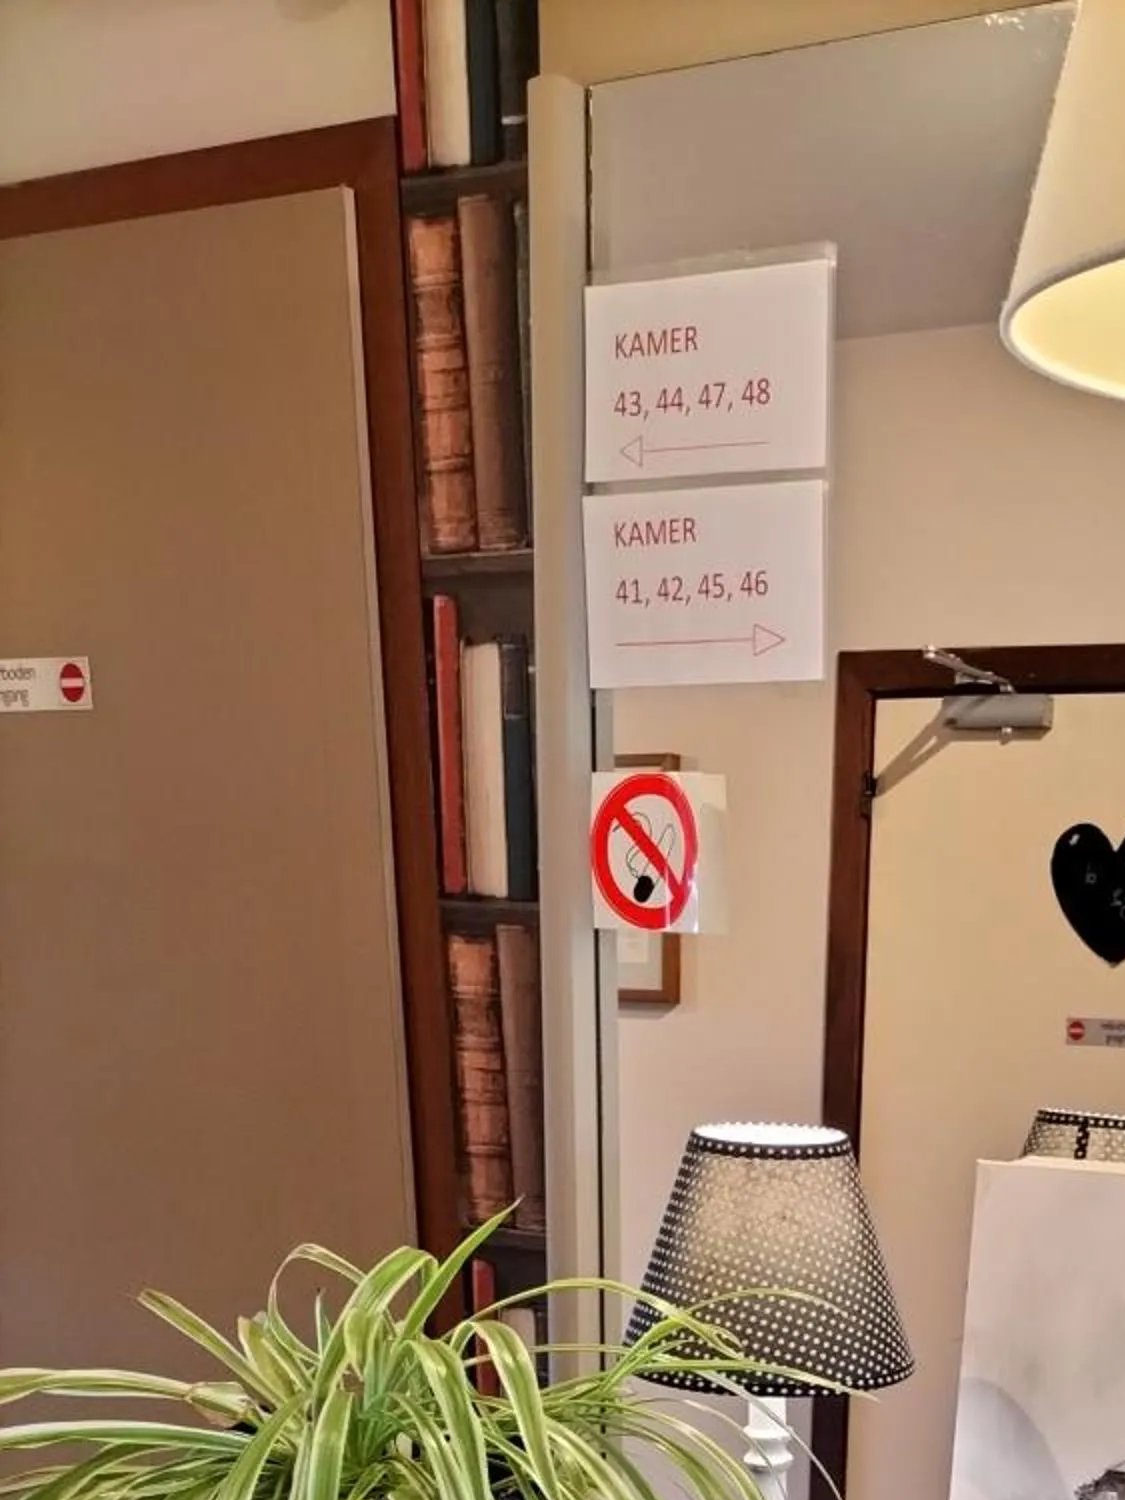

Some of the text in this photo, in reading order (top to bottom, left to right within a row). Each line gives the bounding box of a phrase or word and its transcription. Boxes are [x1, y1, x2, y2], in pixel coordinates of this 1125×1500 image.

[614, 326, 698, 359] KAMER
[613, 377, 771, 421] 43, 44, 47, 48
[614, 517, 697, 548] KAMER
[615, 570, 769, 607] 41, 42, 45, 46
